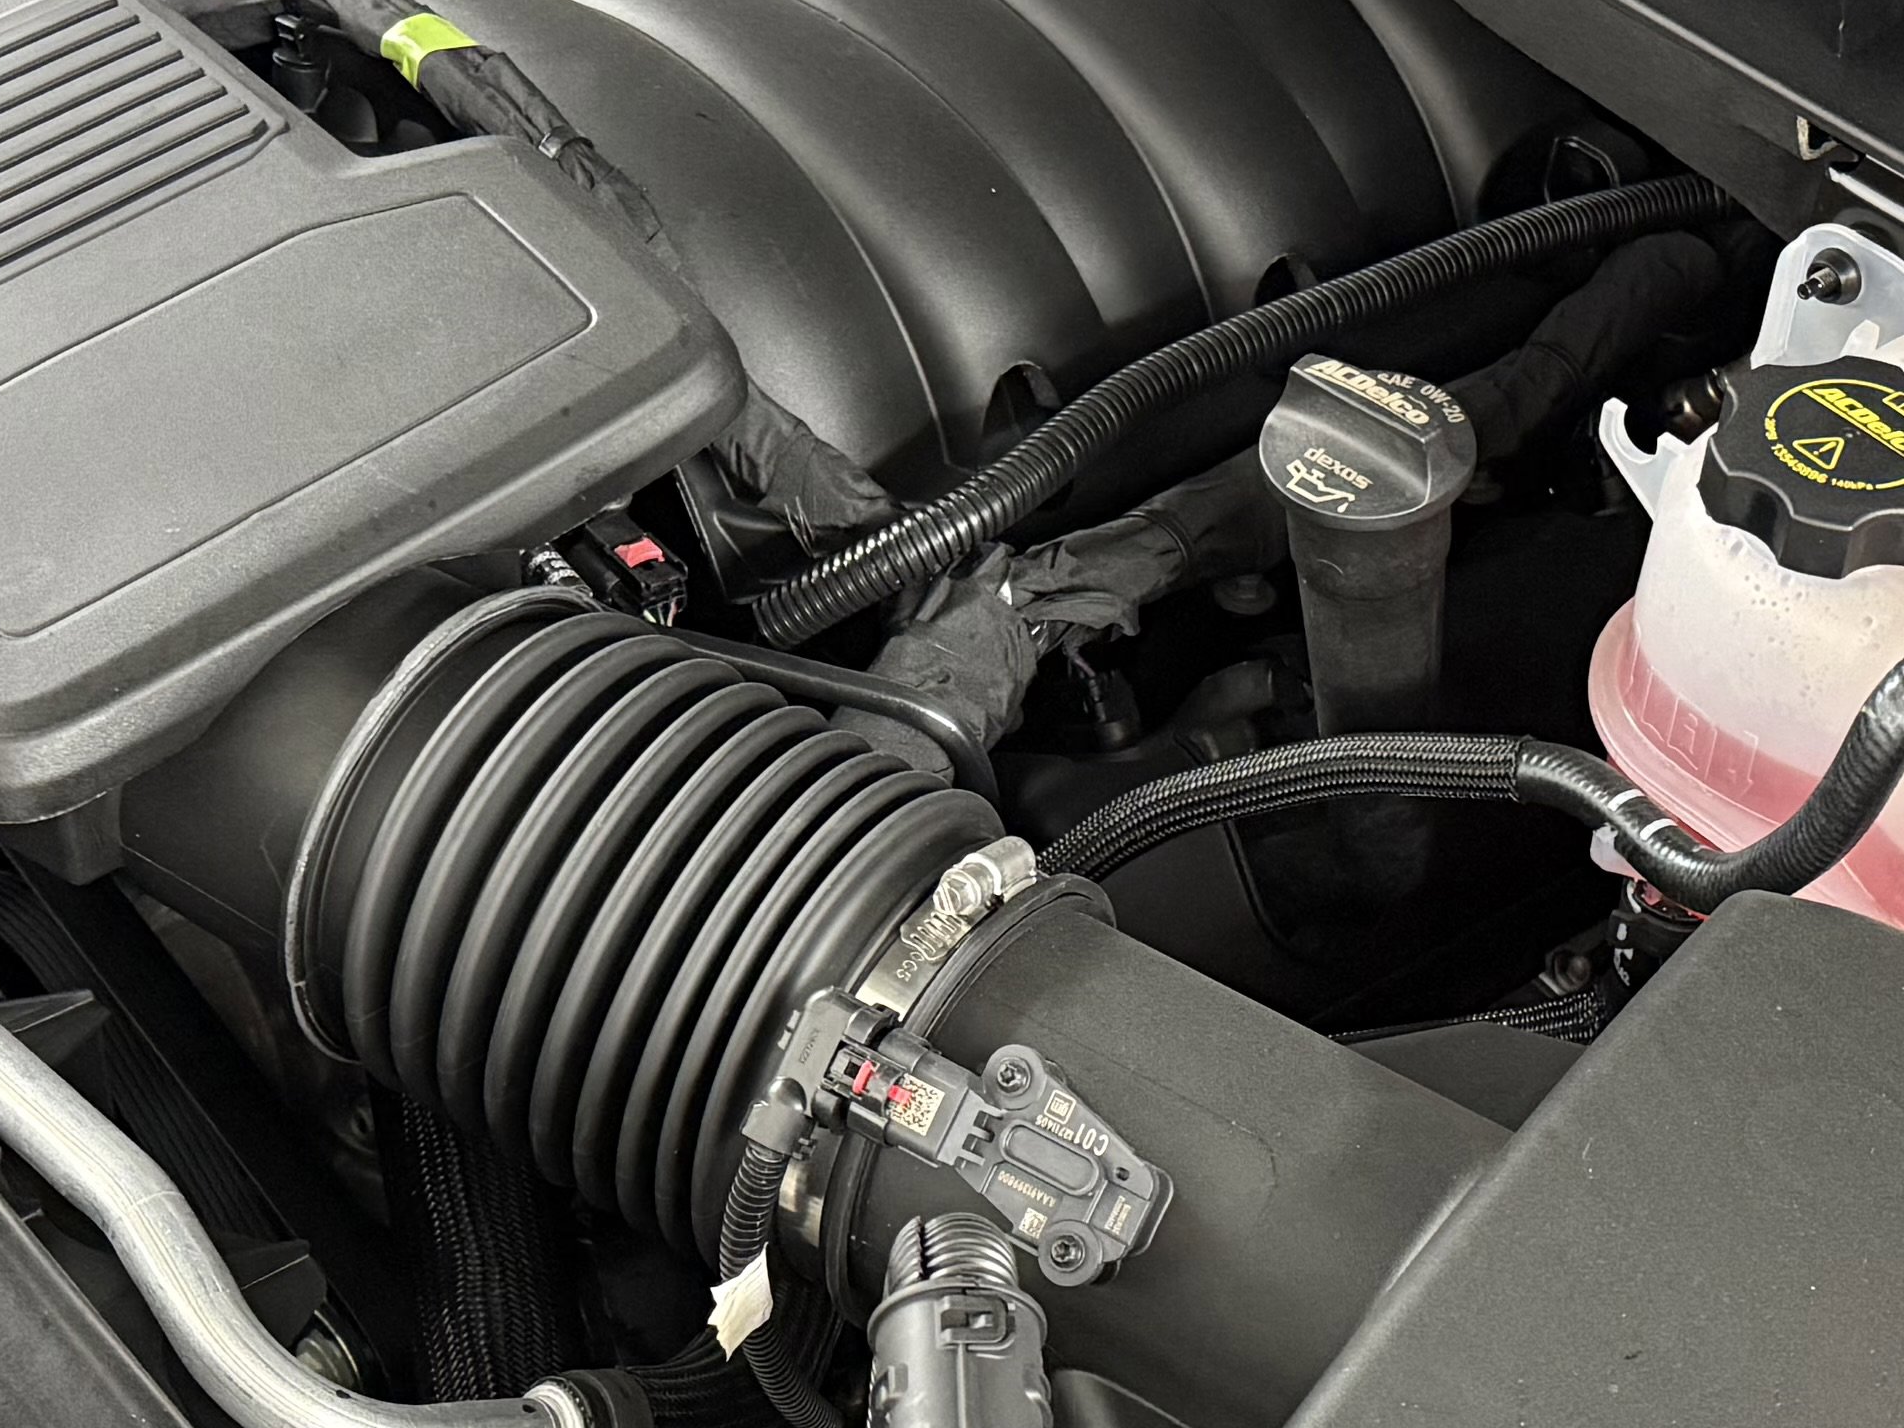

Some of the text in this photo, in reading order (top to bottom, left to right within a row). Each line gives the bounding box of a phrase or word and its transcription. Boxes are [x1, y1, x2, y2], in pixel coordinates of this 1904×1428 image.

[1304, 360, 1429, 425] ACDelco
[1420, 384, 1465, 423] 0W-20
[1304, 447, 1374, 489] dexos
[1074, 1124, 1109, 1156] C01
